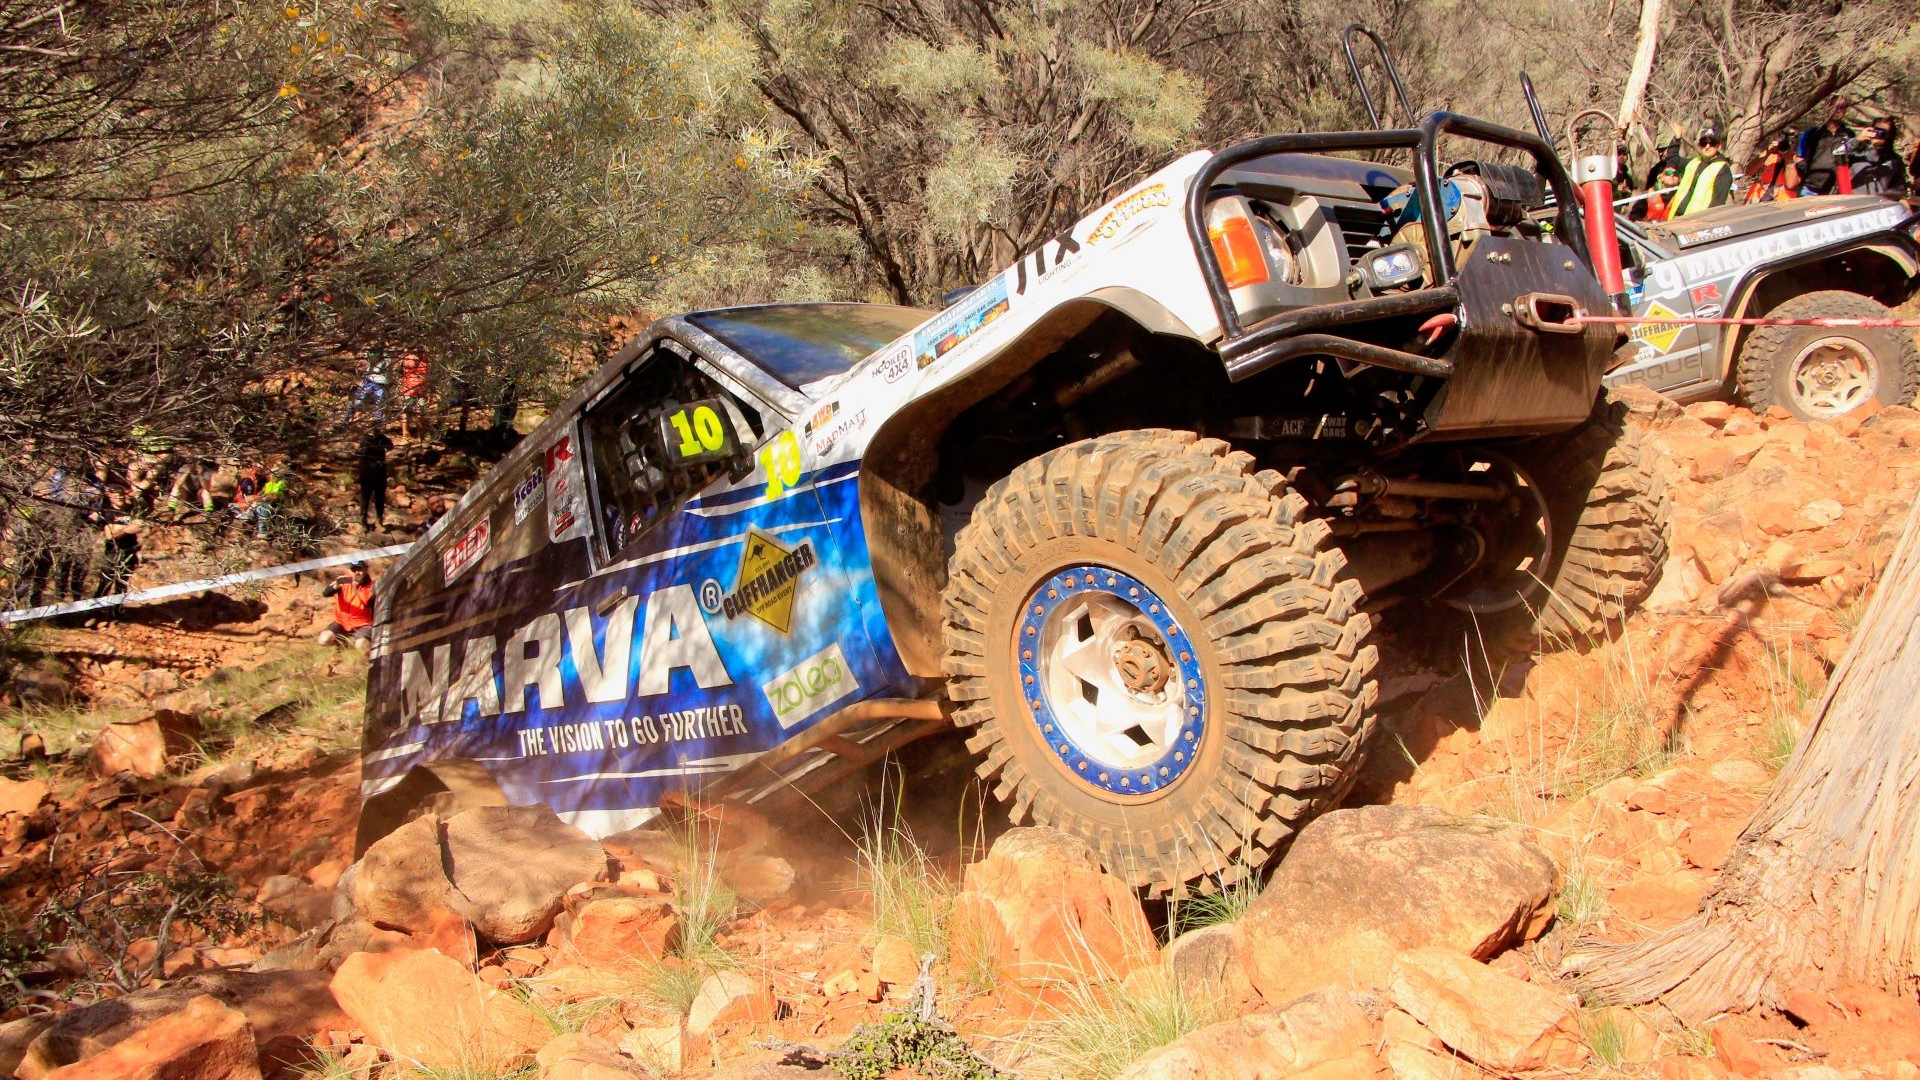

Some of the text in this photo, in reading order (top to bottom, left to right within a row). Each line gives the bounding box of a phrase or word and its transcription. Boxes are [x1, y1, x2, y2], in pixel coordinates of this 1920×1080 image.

[1687, 206, 1903, 280] DAKOTA RACING
[1038, 259, 1072, 285] LIGHTING
[1655, 263, 1684, 300] 9
[1692, 283, 1722, 303] R
[1610, 353, 1700, 387] ORQUE
[670, 406, 724, 457] 10
[760, 430, 801, 502] 10
[723, 543, 815, 621] CLIFFHANGER
[777, 586, 793, 601] EVENT
[400, 583, 734, 726] NARVA
[518, 727, 547, 757] THE
[549, 720, 605, 754] VISION
[604, 718, 629, 749] TO
[631, 715, 659, 745] GO
[659, 704, 748, 743] FURTHER
